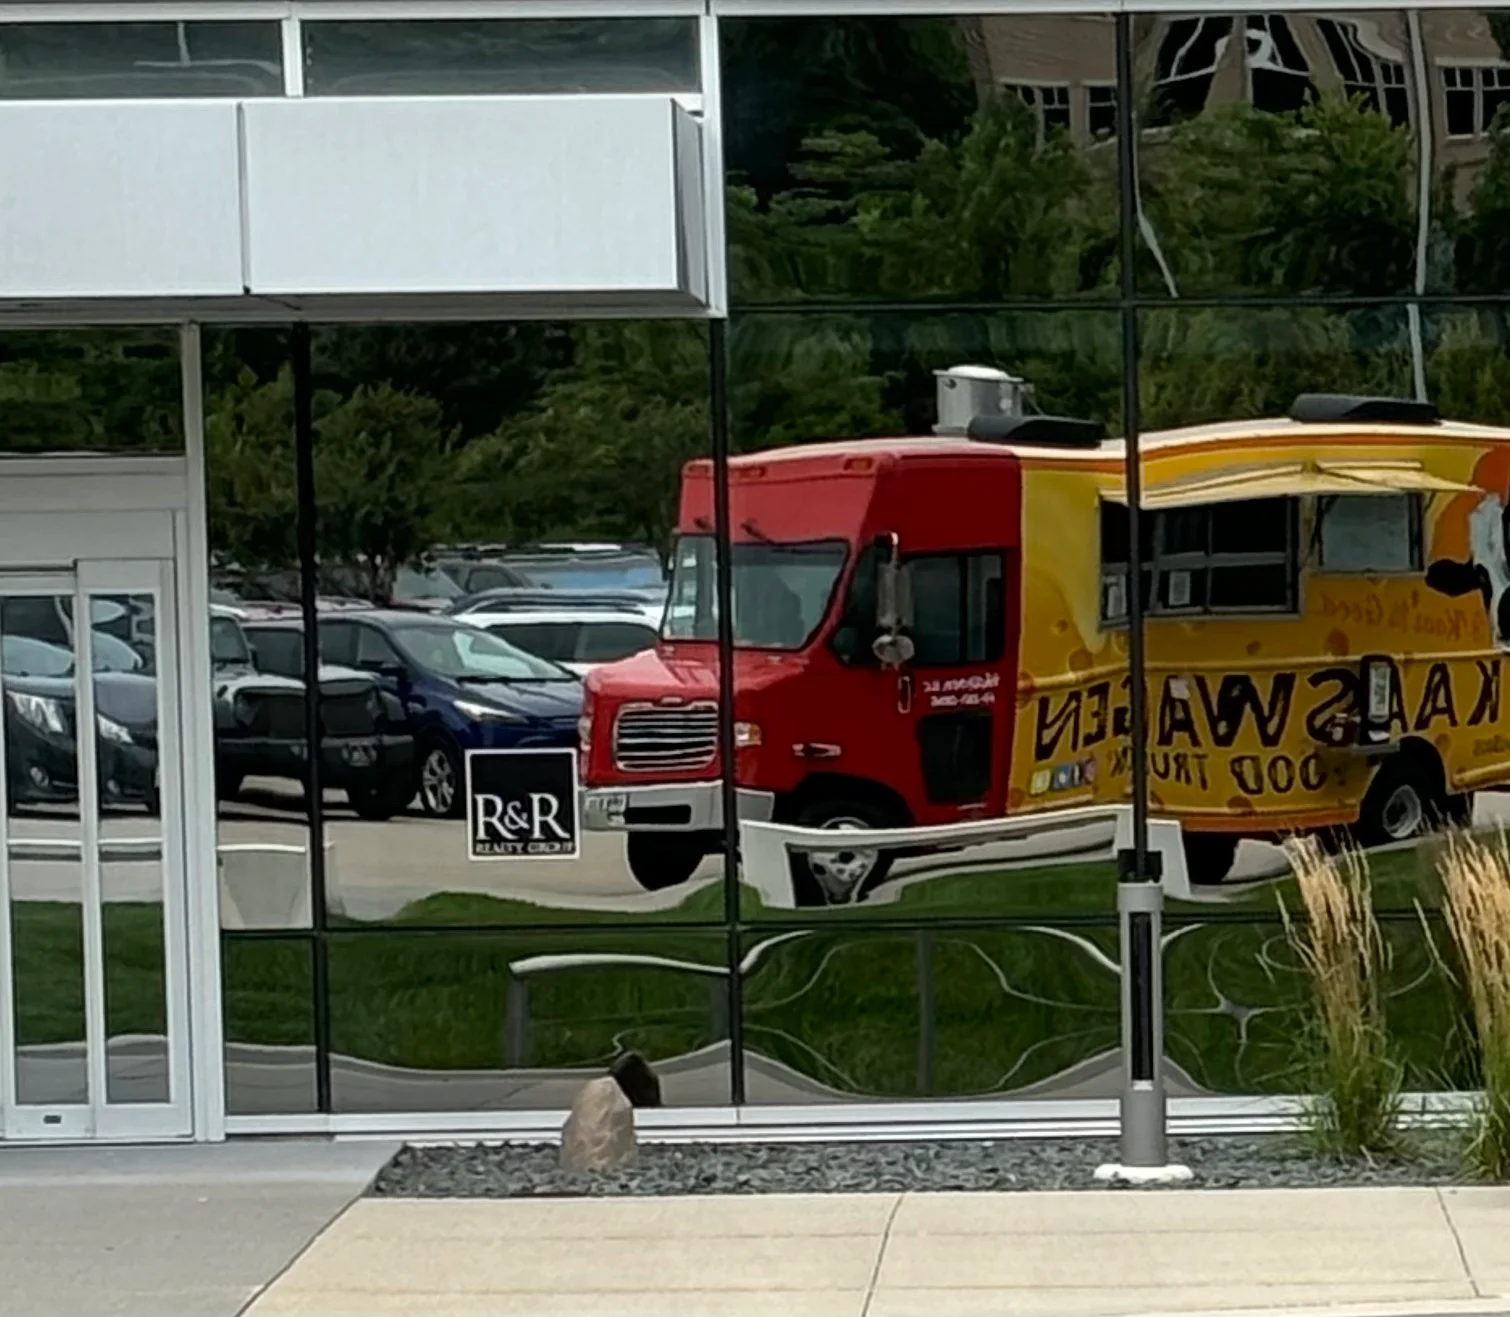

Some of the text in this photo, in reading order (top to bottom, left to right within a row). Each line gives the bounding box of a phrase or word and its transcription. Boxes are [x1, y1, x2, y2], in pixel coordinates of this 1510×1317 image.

[474, 793, 571, 840] R&R
[475, 841, 576, 854] REALTY GROUP
